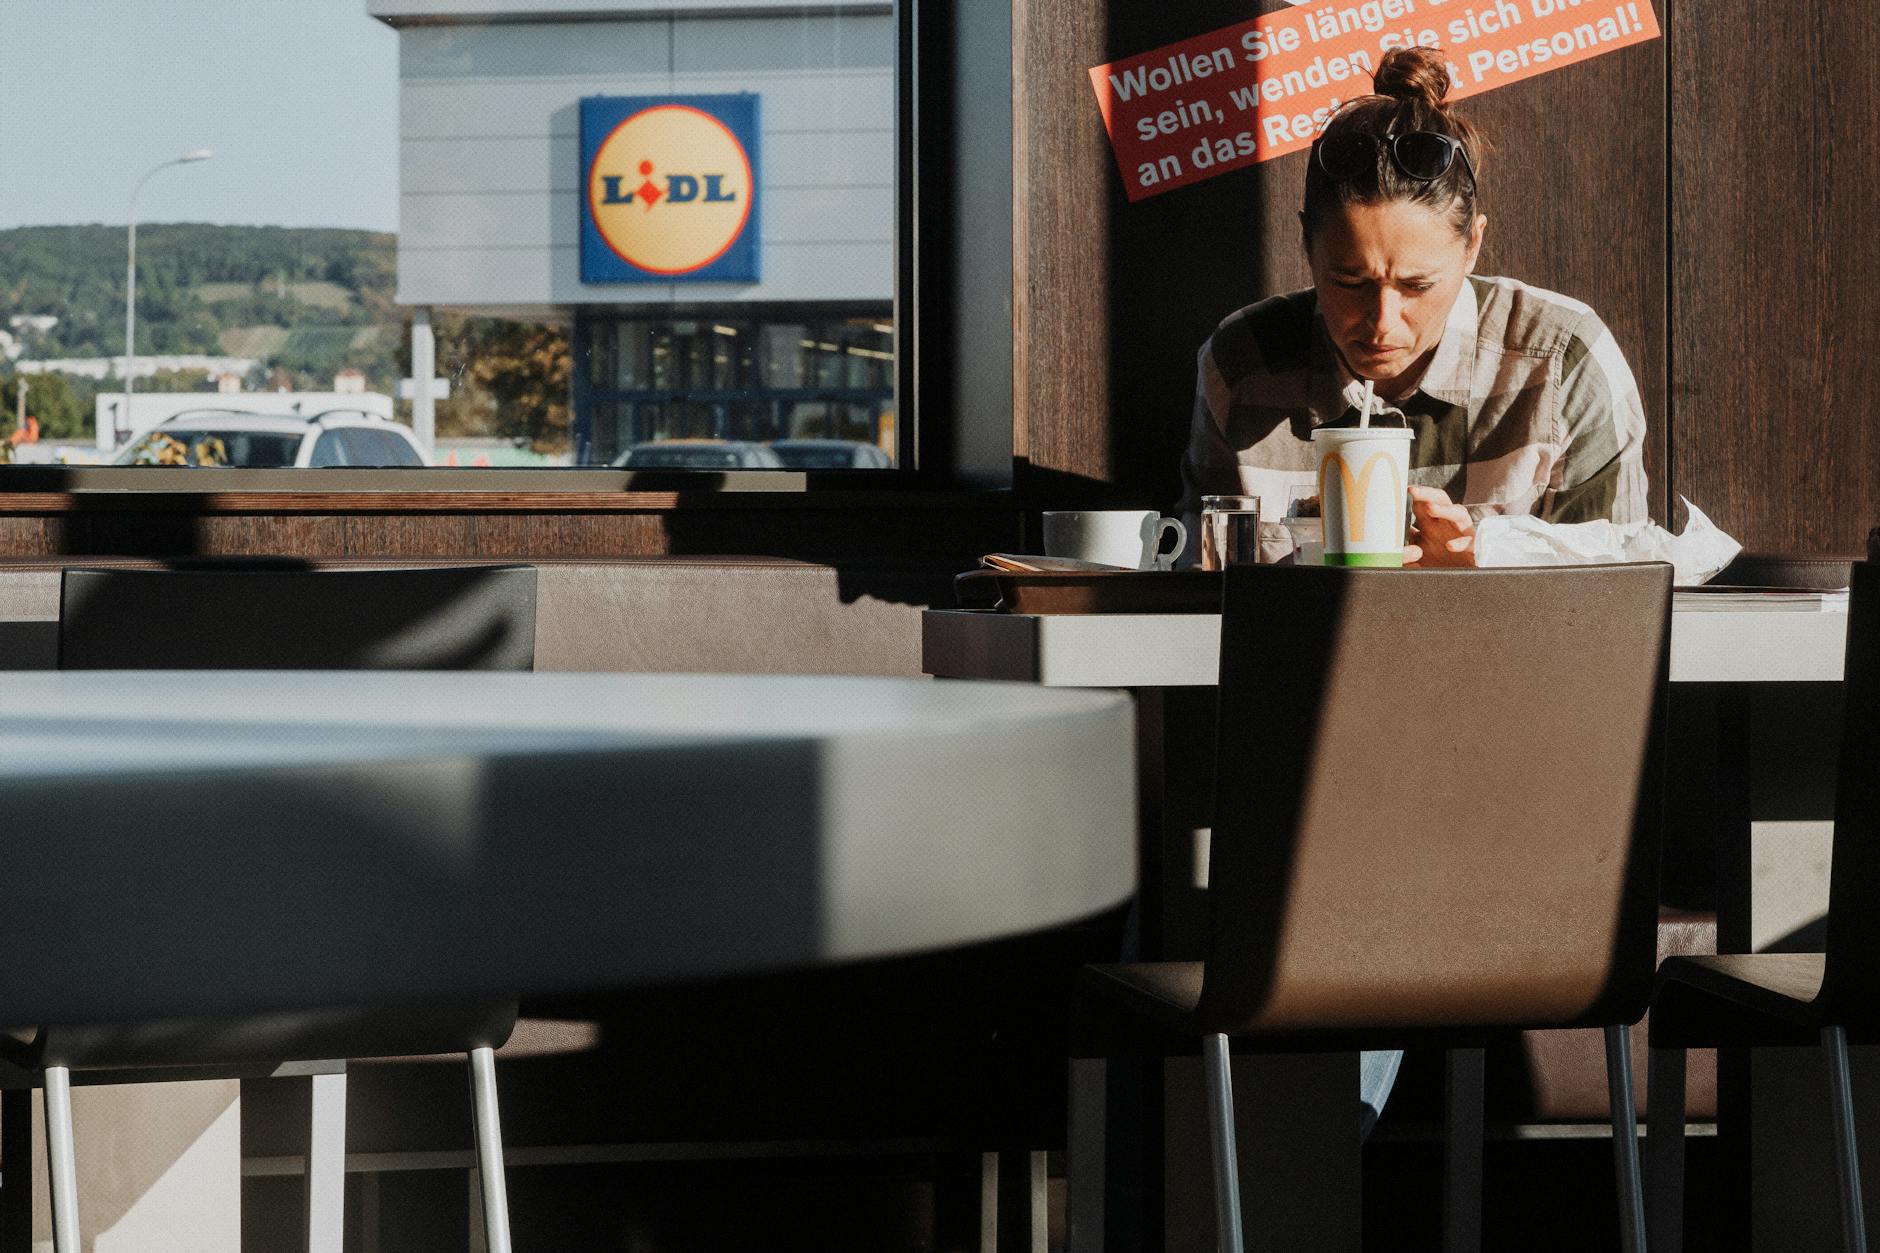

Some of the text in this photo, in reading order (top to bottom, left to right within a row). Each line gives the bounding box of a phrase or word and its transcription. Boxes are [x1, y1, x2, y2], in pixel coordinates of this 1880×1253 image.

[1109, 47, 1236, 102] Wollen
[1241, 26, 1300, 61] Sie
[1137, 99, 1225, 142] sein,
[1229, 49, 1372, 111] wenden
[1448, 0, 1522, 43] sich
[1138, 155, 1182, 187] an
[1191, 132, 1257, 169] das
[1468, 2, 1643, 82] Personal!
